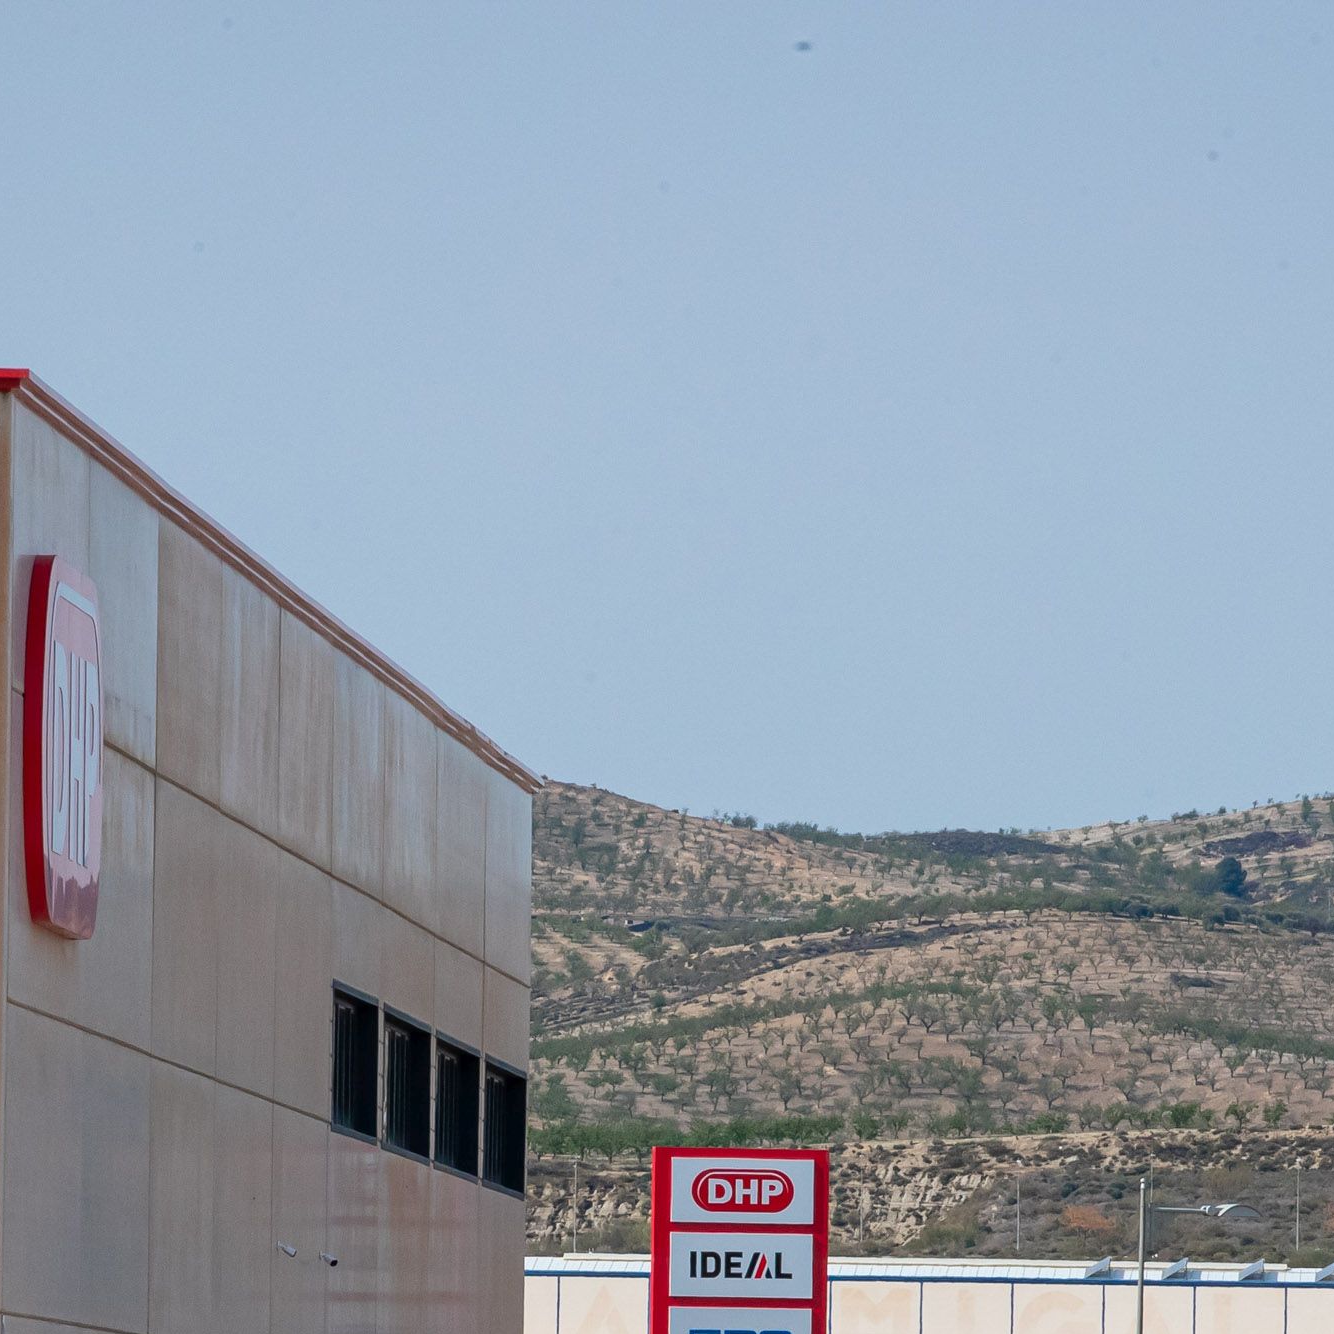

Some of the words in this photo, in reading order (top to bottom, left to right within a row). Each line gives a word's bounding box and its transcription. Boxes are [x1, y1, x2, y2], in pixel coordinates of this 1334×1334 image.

[52, 640, 99, 868] DHP
[707, 1178, 784, 1205] DHP
[689, 1251, 793, 1279] IDEAL
